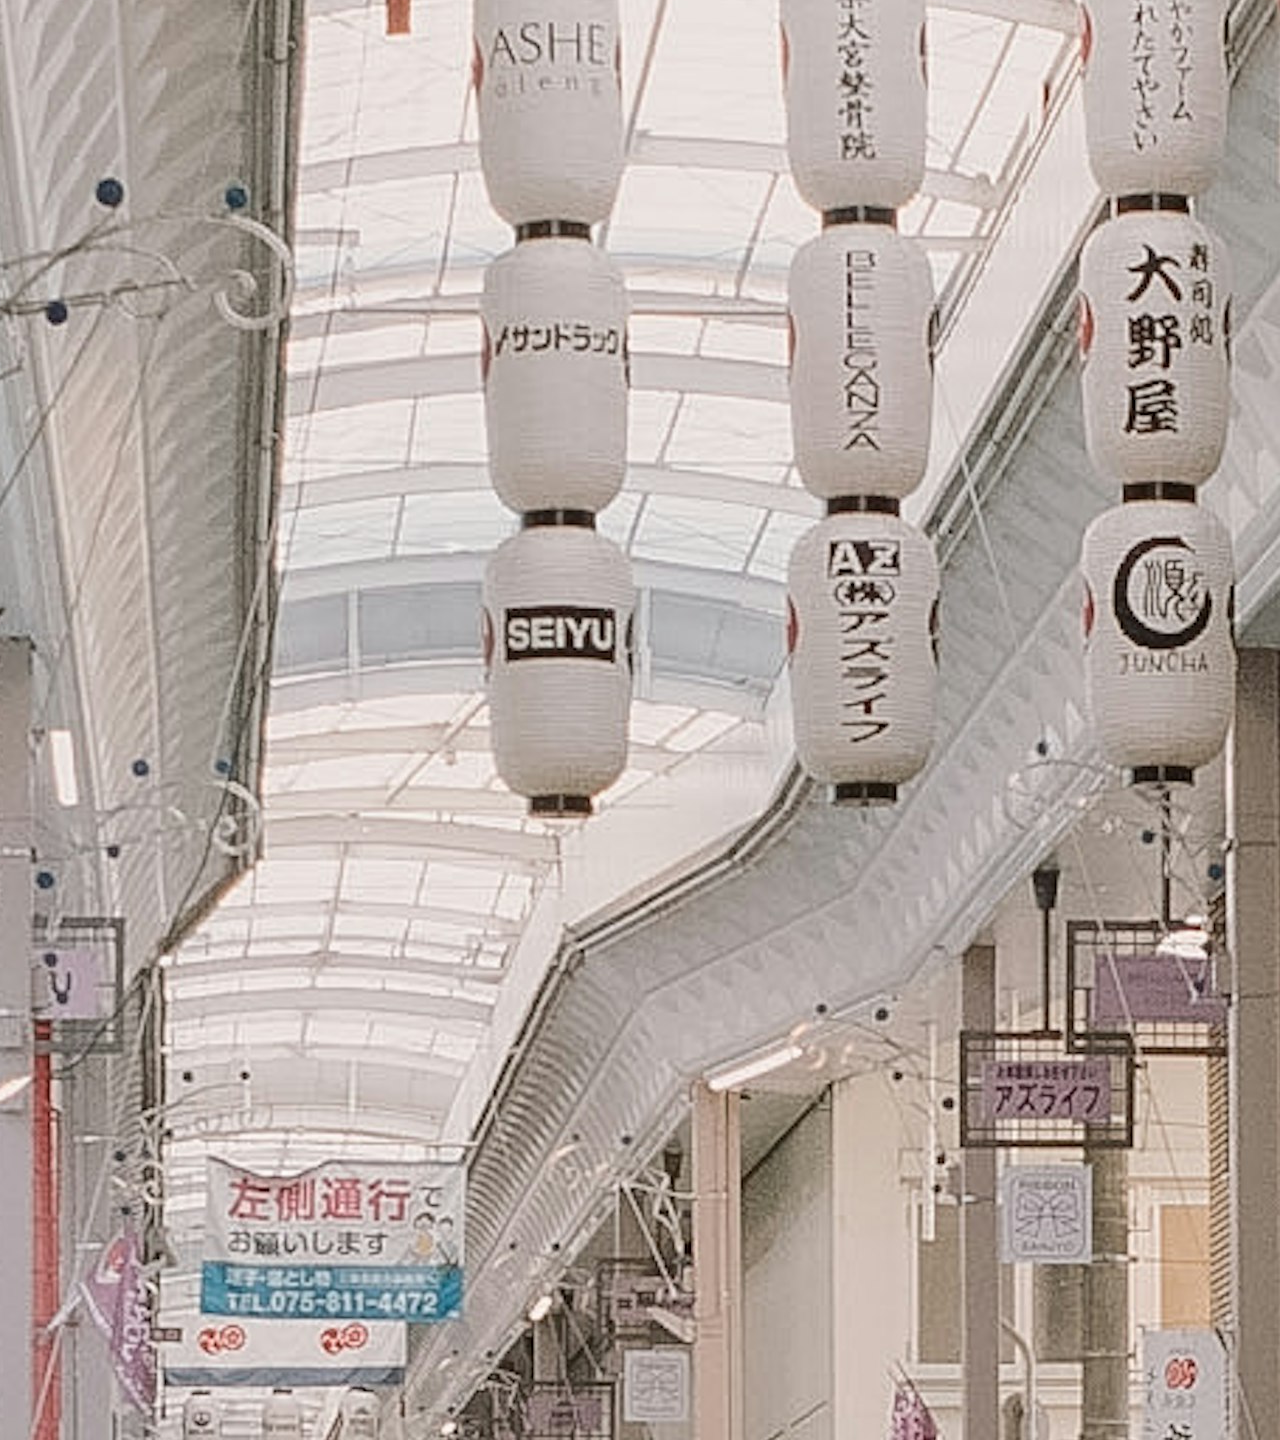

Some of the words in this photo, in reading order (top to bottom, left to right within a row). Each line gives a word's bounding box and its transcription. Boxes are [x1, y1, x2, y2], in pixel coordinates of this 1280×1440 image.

[489, 21, 606, 68] ASHE
[512, 321, 620, 356] サンドラッグ
[1122, 243, 1184, 436] 大野屋
[506, 617, 615, 652] SEIYU
[994, 1084, 1100, 1115] アズライフ
[228, 1176, 444, 1223] 左側通行で
[227, 1230, 389, 1256] お願いします
